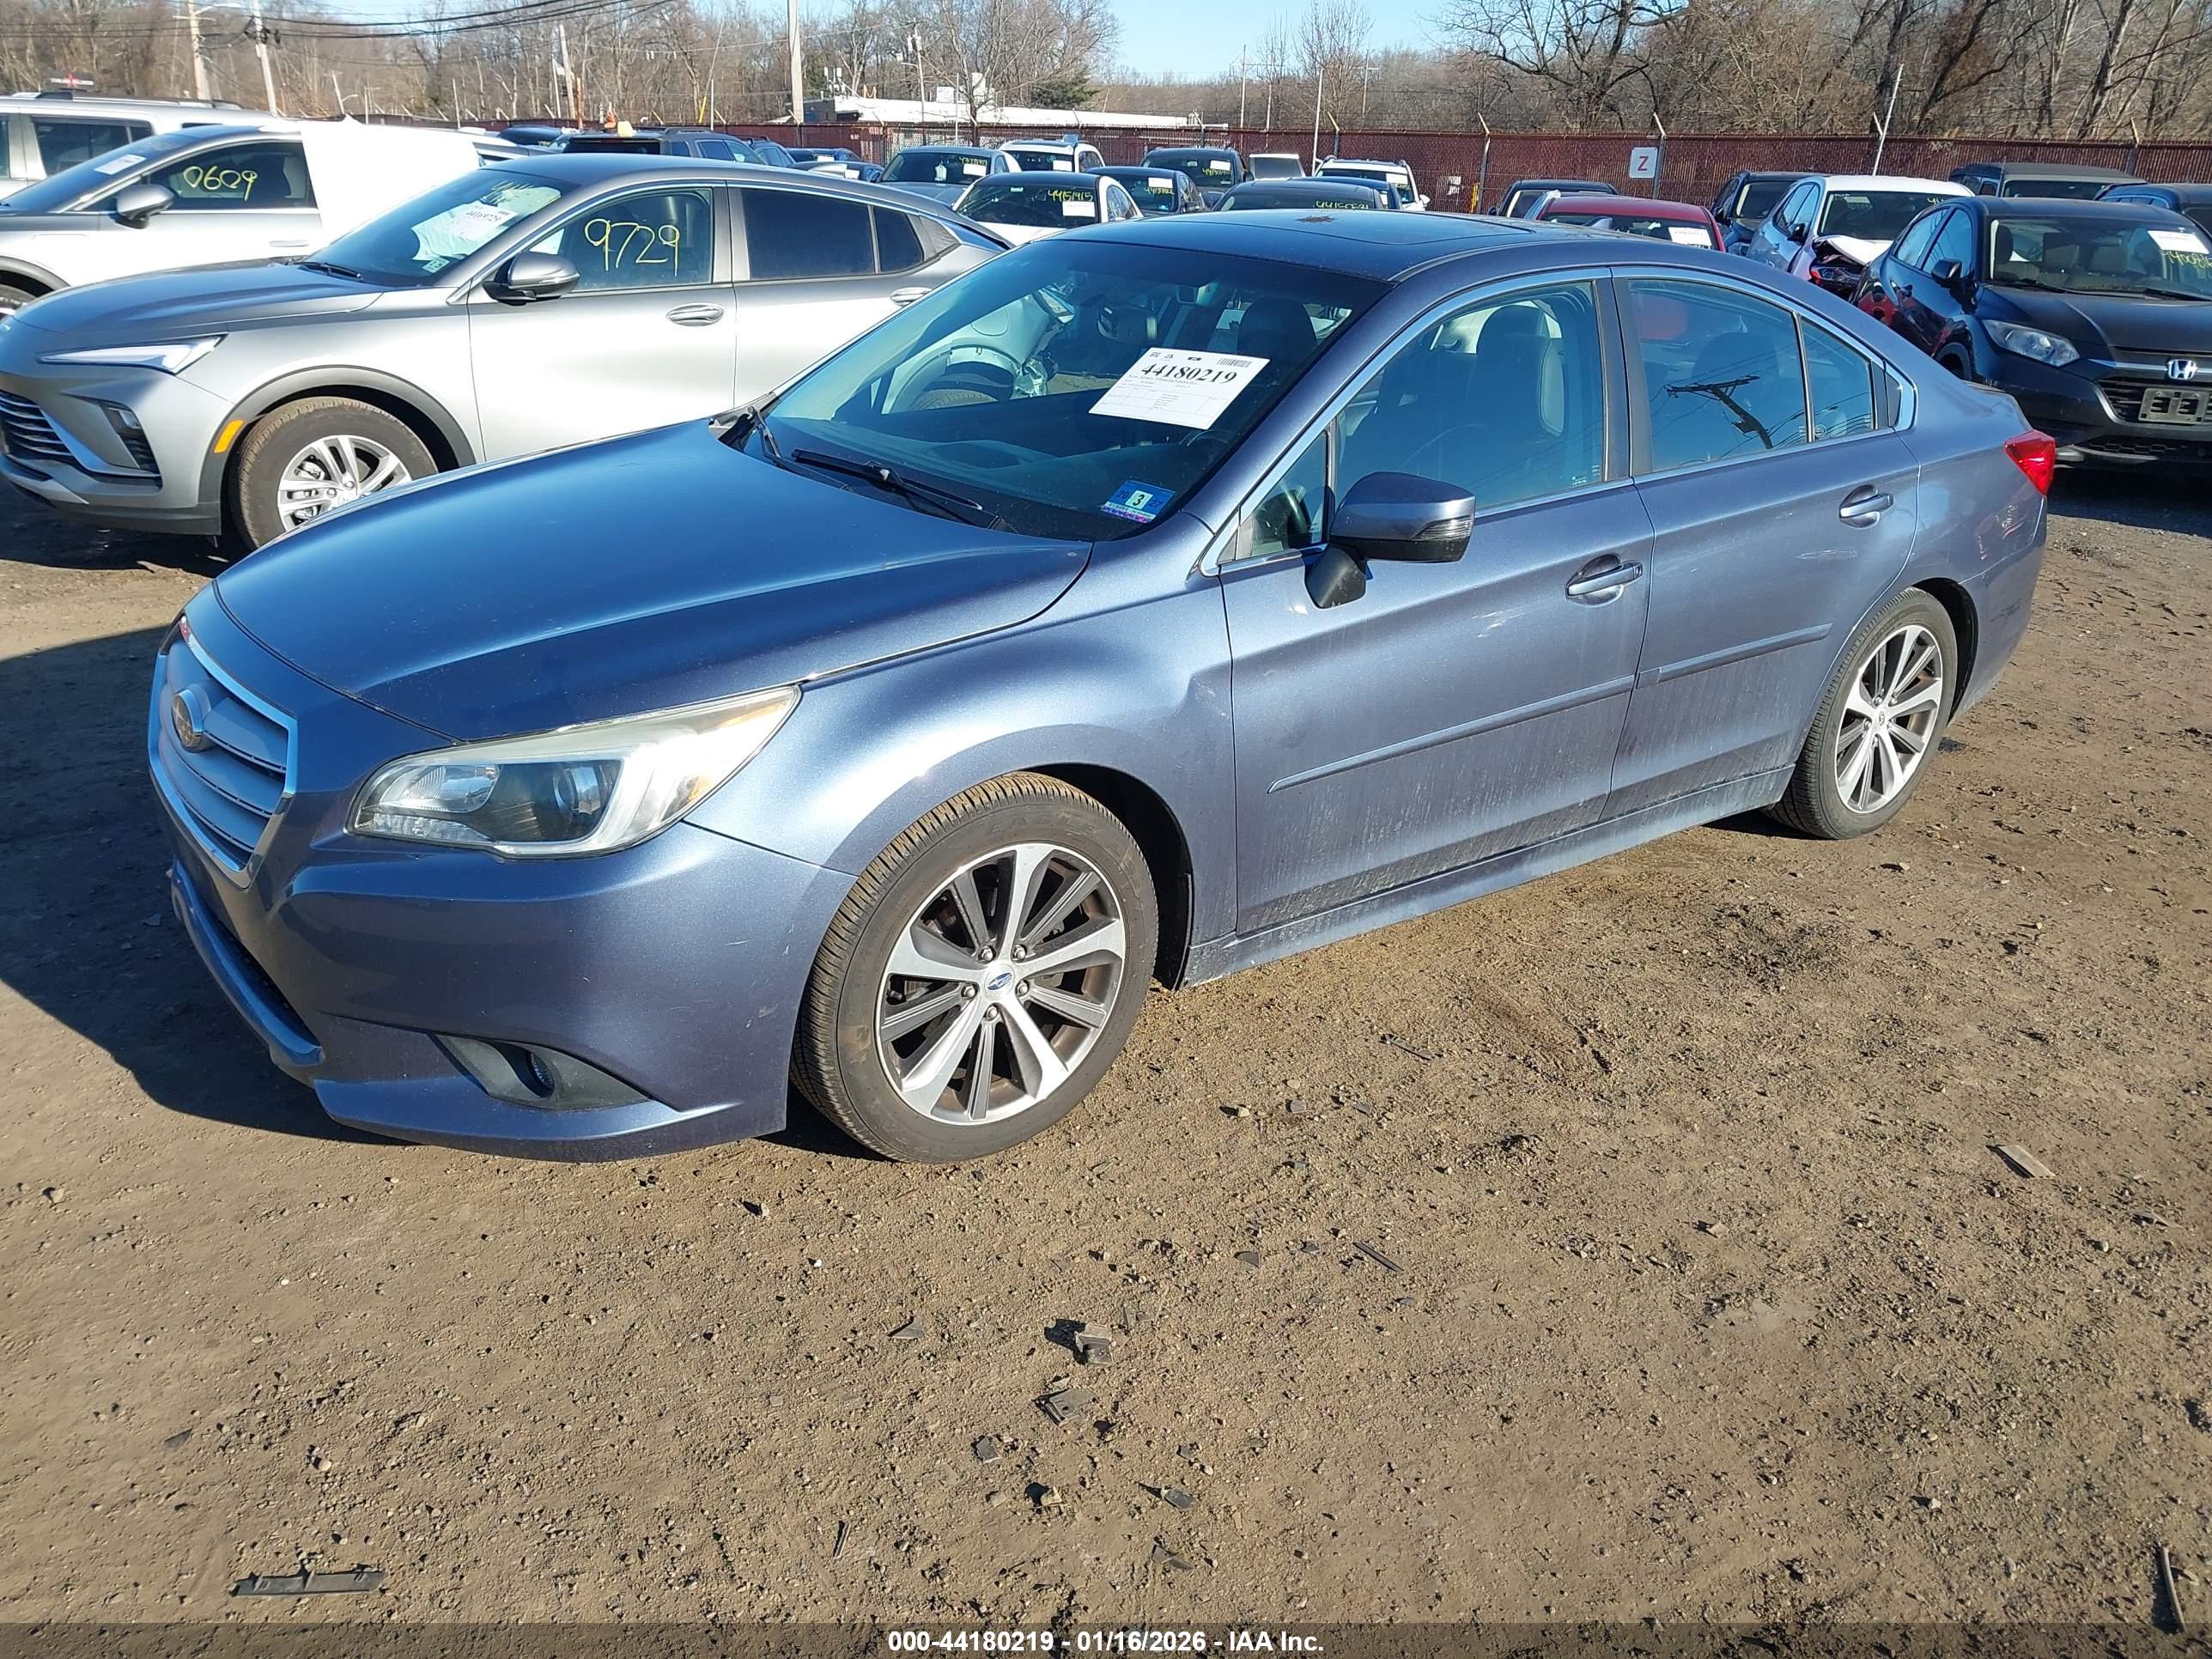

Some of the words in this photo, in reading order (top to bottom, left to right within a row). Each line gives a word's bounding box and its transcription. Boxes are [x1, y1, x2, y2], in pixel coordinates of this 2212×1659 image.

[1637, 155, 1650, 172] Z
[183, 165, 258, 202] 0609
[584, 218, 680, 276] 9729
[1141, 363, 1237, 384] 44180219
[1133, 494, 1146, 507] 3
